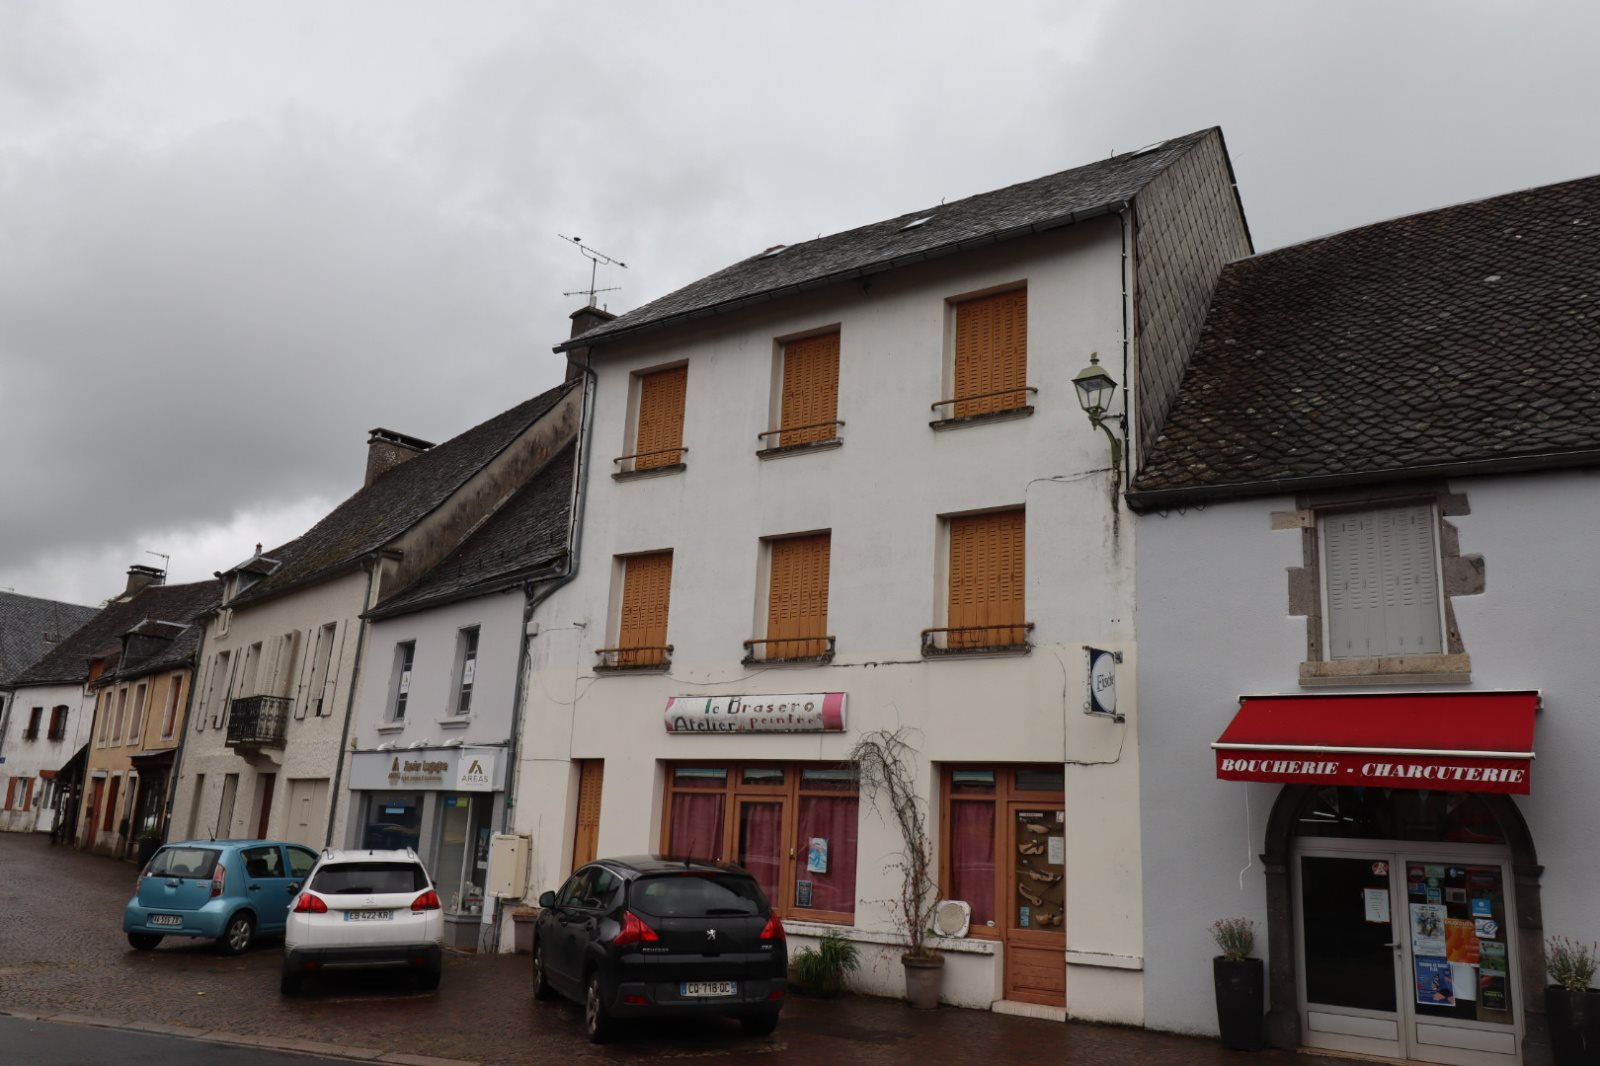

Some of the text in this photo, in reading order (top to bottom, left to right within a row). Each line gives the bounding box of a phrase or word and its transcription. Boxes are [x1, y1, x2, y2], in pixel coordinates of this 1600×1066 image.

[727, 696, 815, 714] Brasero
[674, 716, 736, 732] Atelier
[461, 775, 489, 784] AREAS
[1220, 758, 1340, 775] BOUCHERIE
[1361, 762, 1526, 784] CHARCUTERIE
